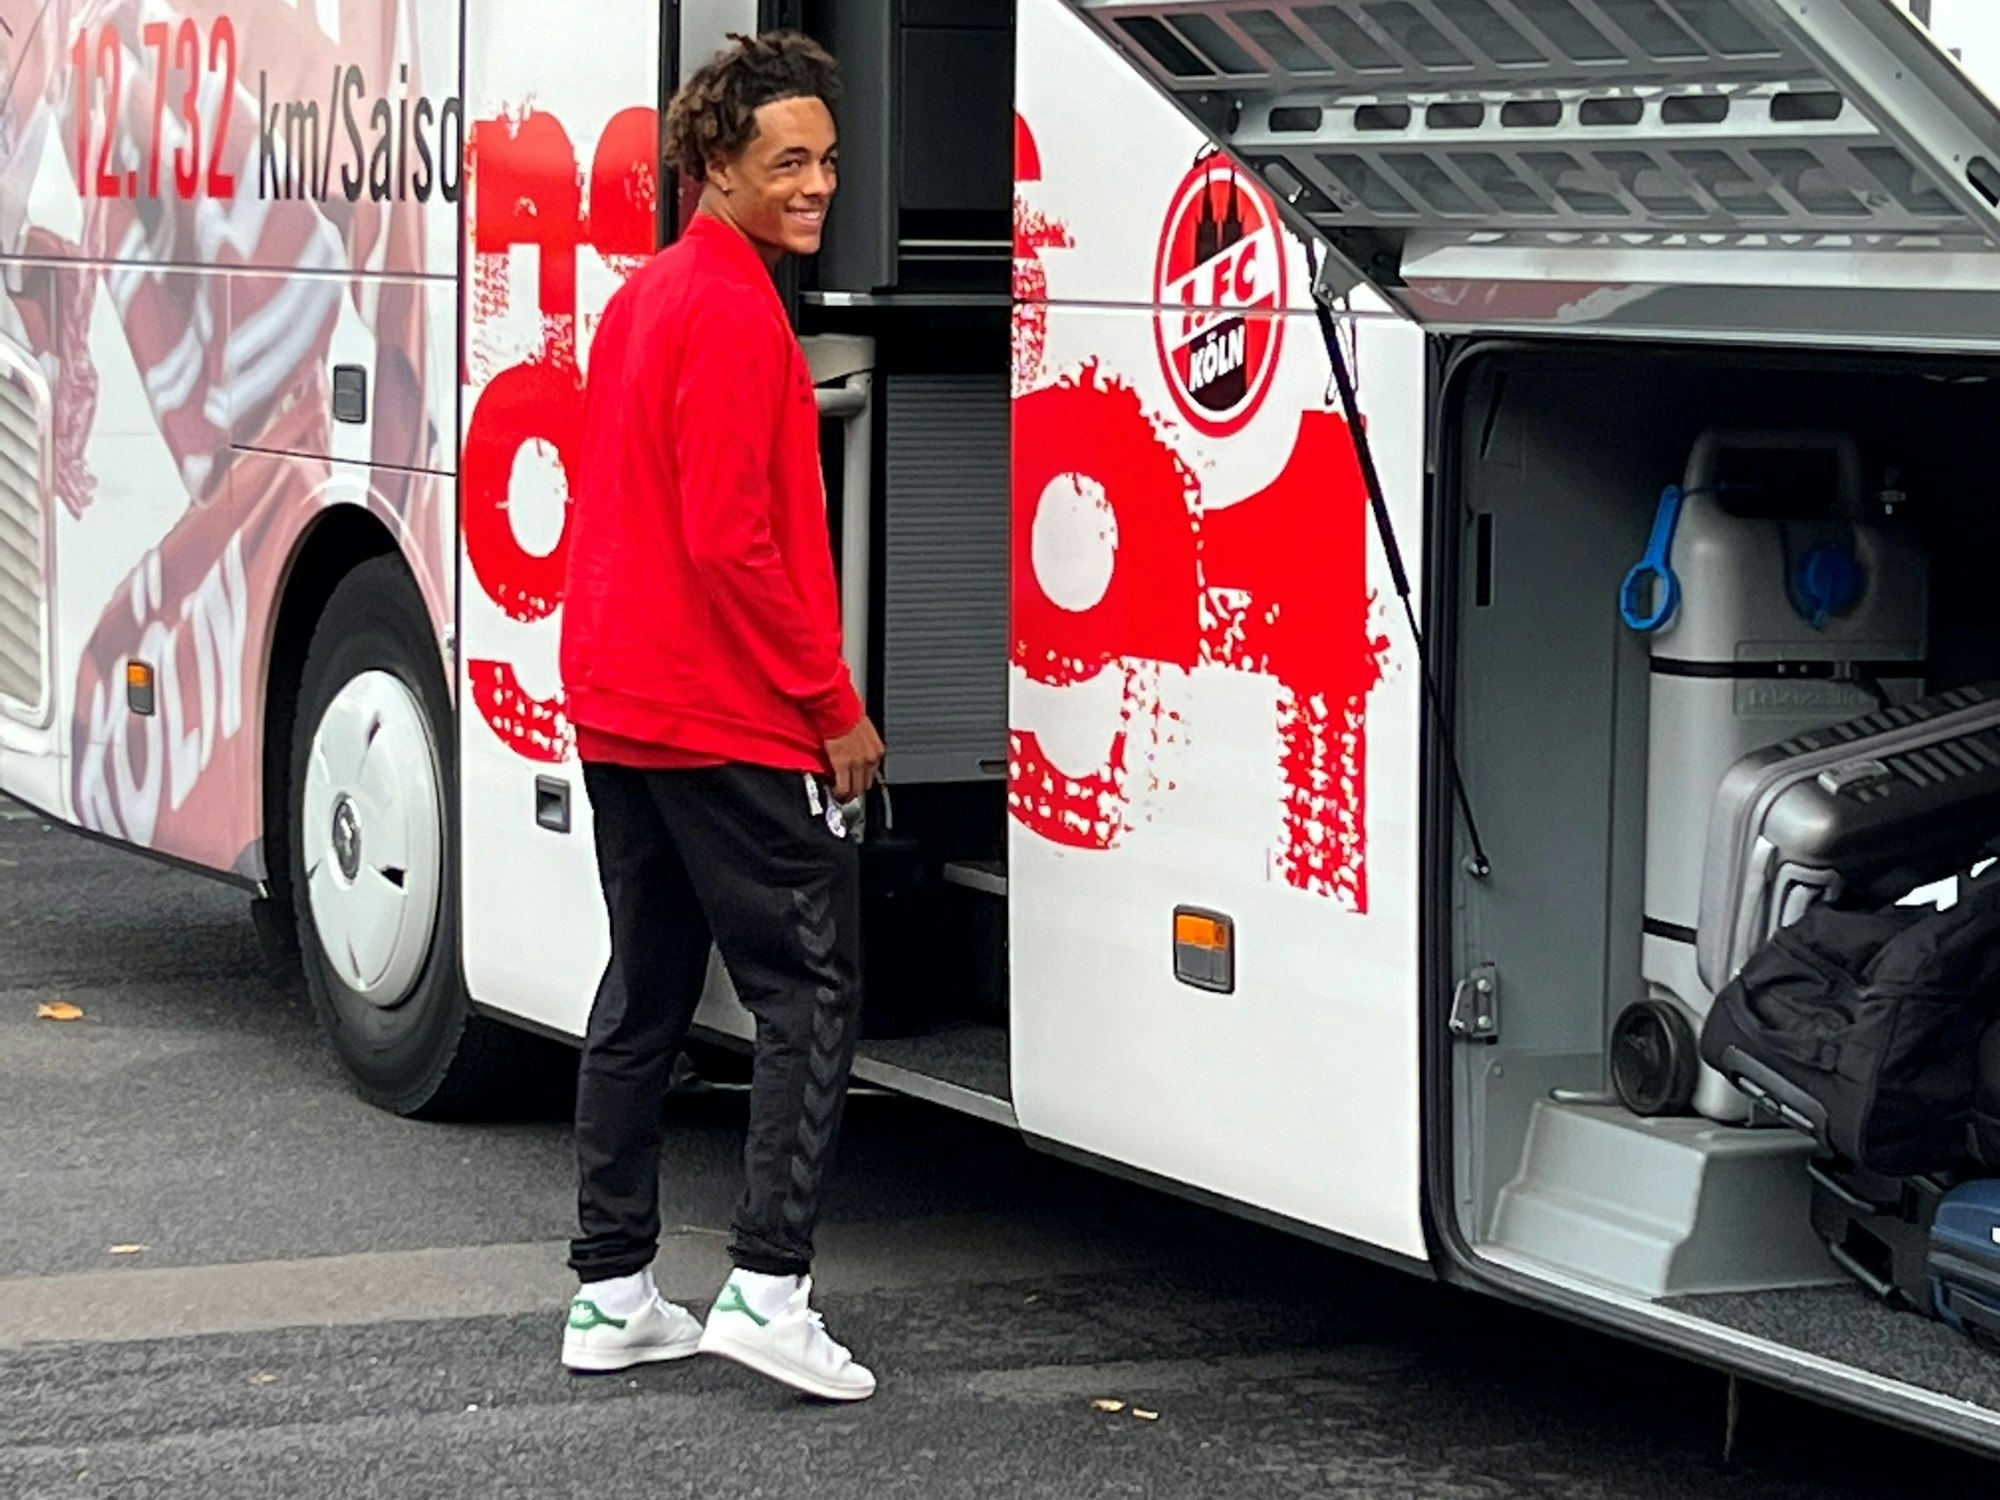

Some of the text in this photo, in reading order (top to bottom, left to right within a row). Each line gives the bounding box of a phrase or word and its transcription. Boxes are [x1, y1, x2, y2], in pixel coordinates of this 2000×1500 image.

[71, 16, 237, 200] 12.732
[1213, 240, 1257, 317] FC
[1189, 325, 1245, 393] KÖLN
